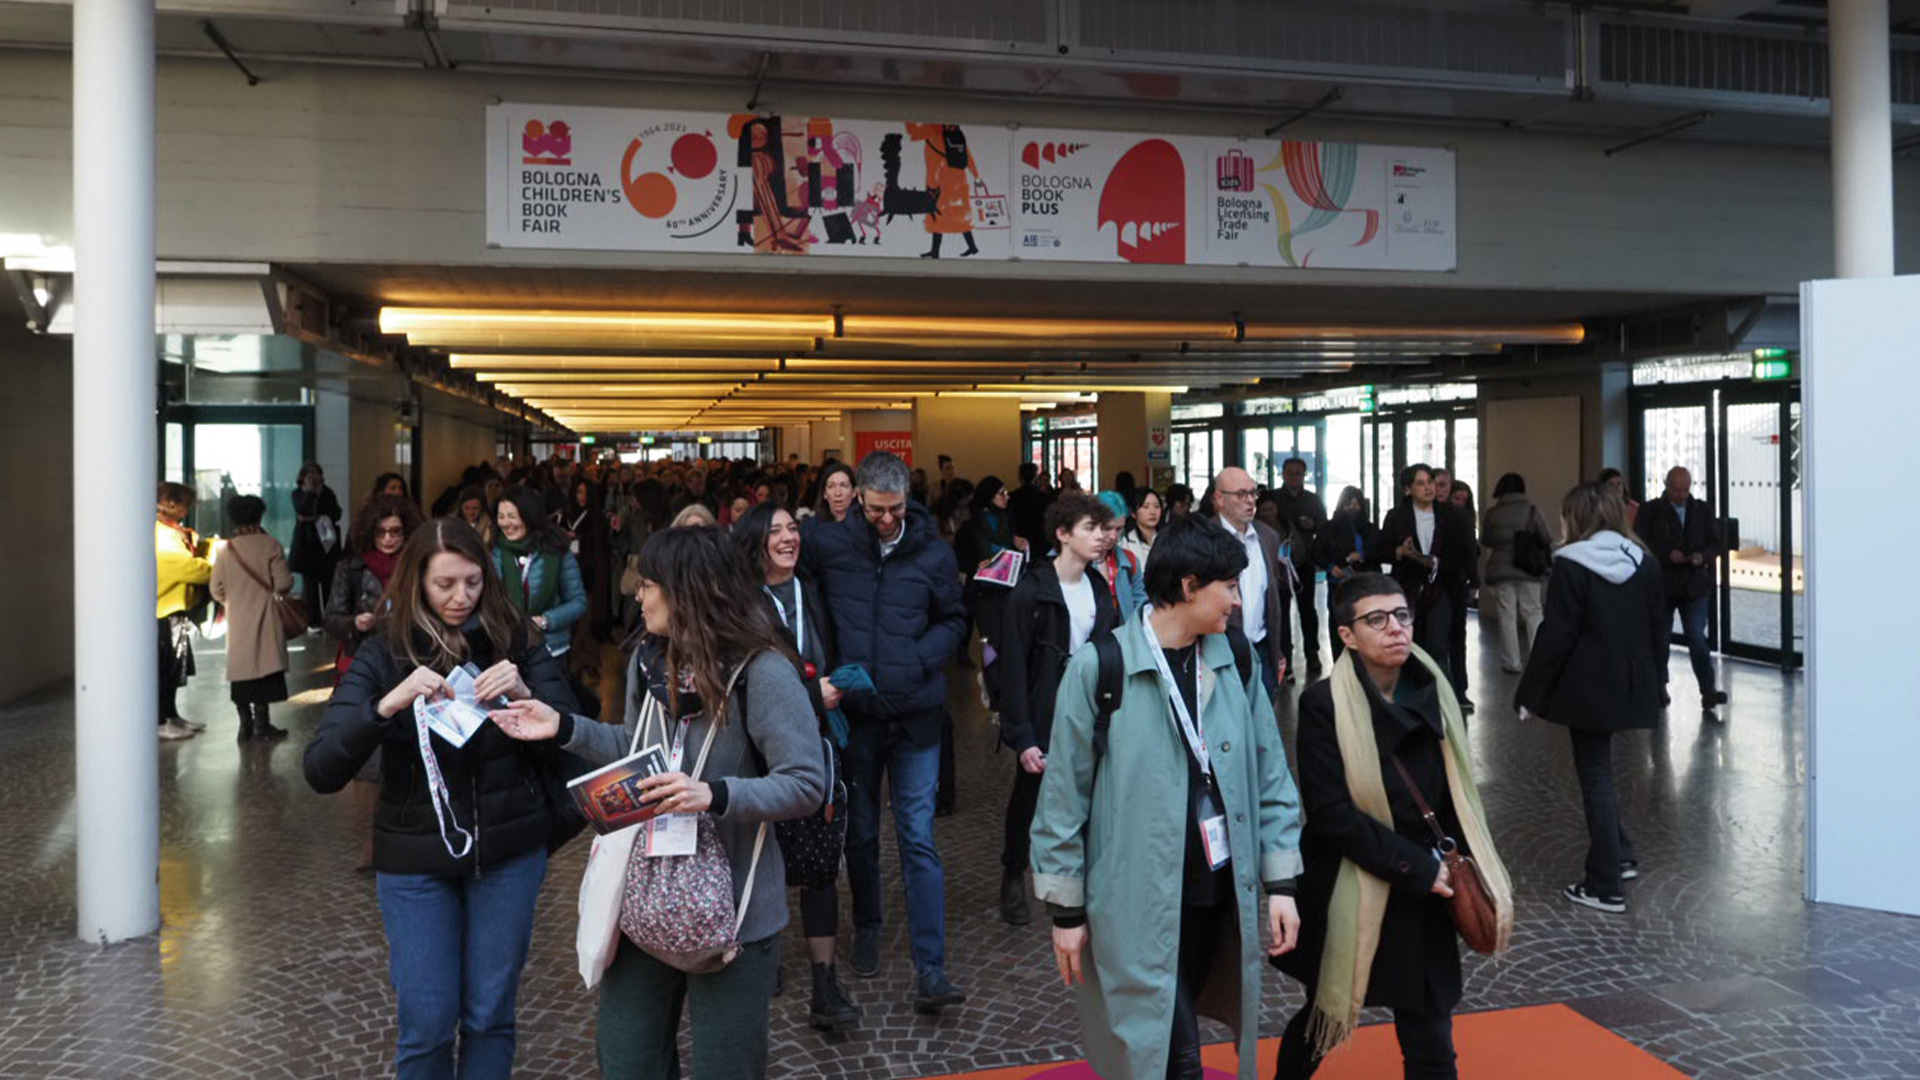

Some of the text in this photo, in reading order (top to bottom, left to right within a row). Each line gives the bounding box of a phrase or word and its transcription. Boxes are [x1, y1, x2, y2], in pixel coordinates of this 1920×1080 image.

[522, 170, 601, 187] BOLOGNA
[1022, 174, 1093, 190] BOLOGNA
[522, 186, 621, 204] CHILDREN'S
[688, 169, 727, 227] ANNIVERSARY
[1022, 188, 1064, 202] BOOK
[522, 203, 567, 218] BOOK
[1022, 202, 1059, 215] PLUS
[1217, 196, 1262, 212] Bologna
[1217, 207, 1269, 223] Licensing
[522, 218, 560, 233] FAIR
[1217, 219, 1248, 230] Trade
[1217, 229, 1239, 240] Fair
[875, 439, 912, 449] USCITA
